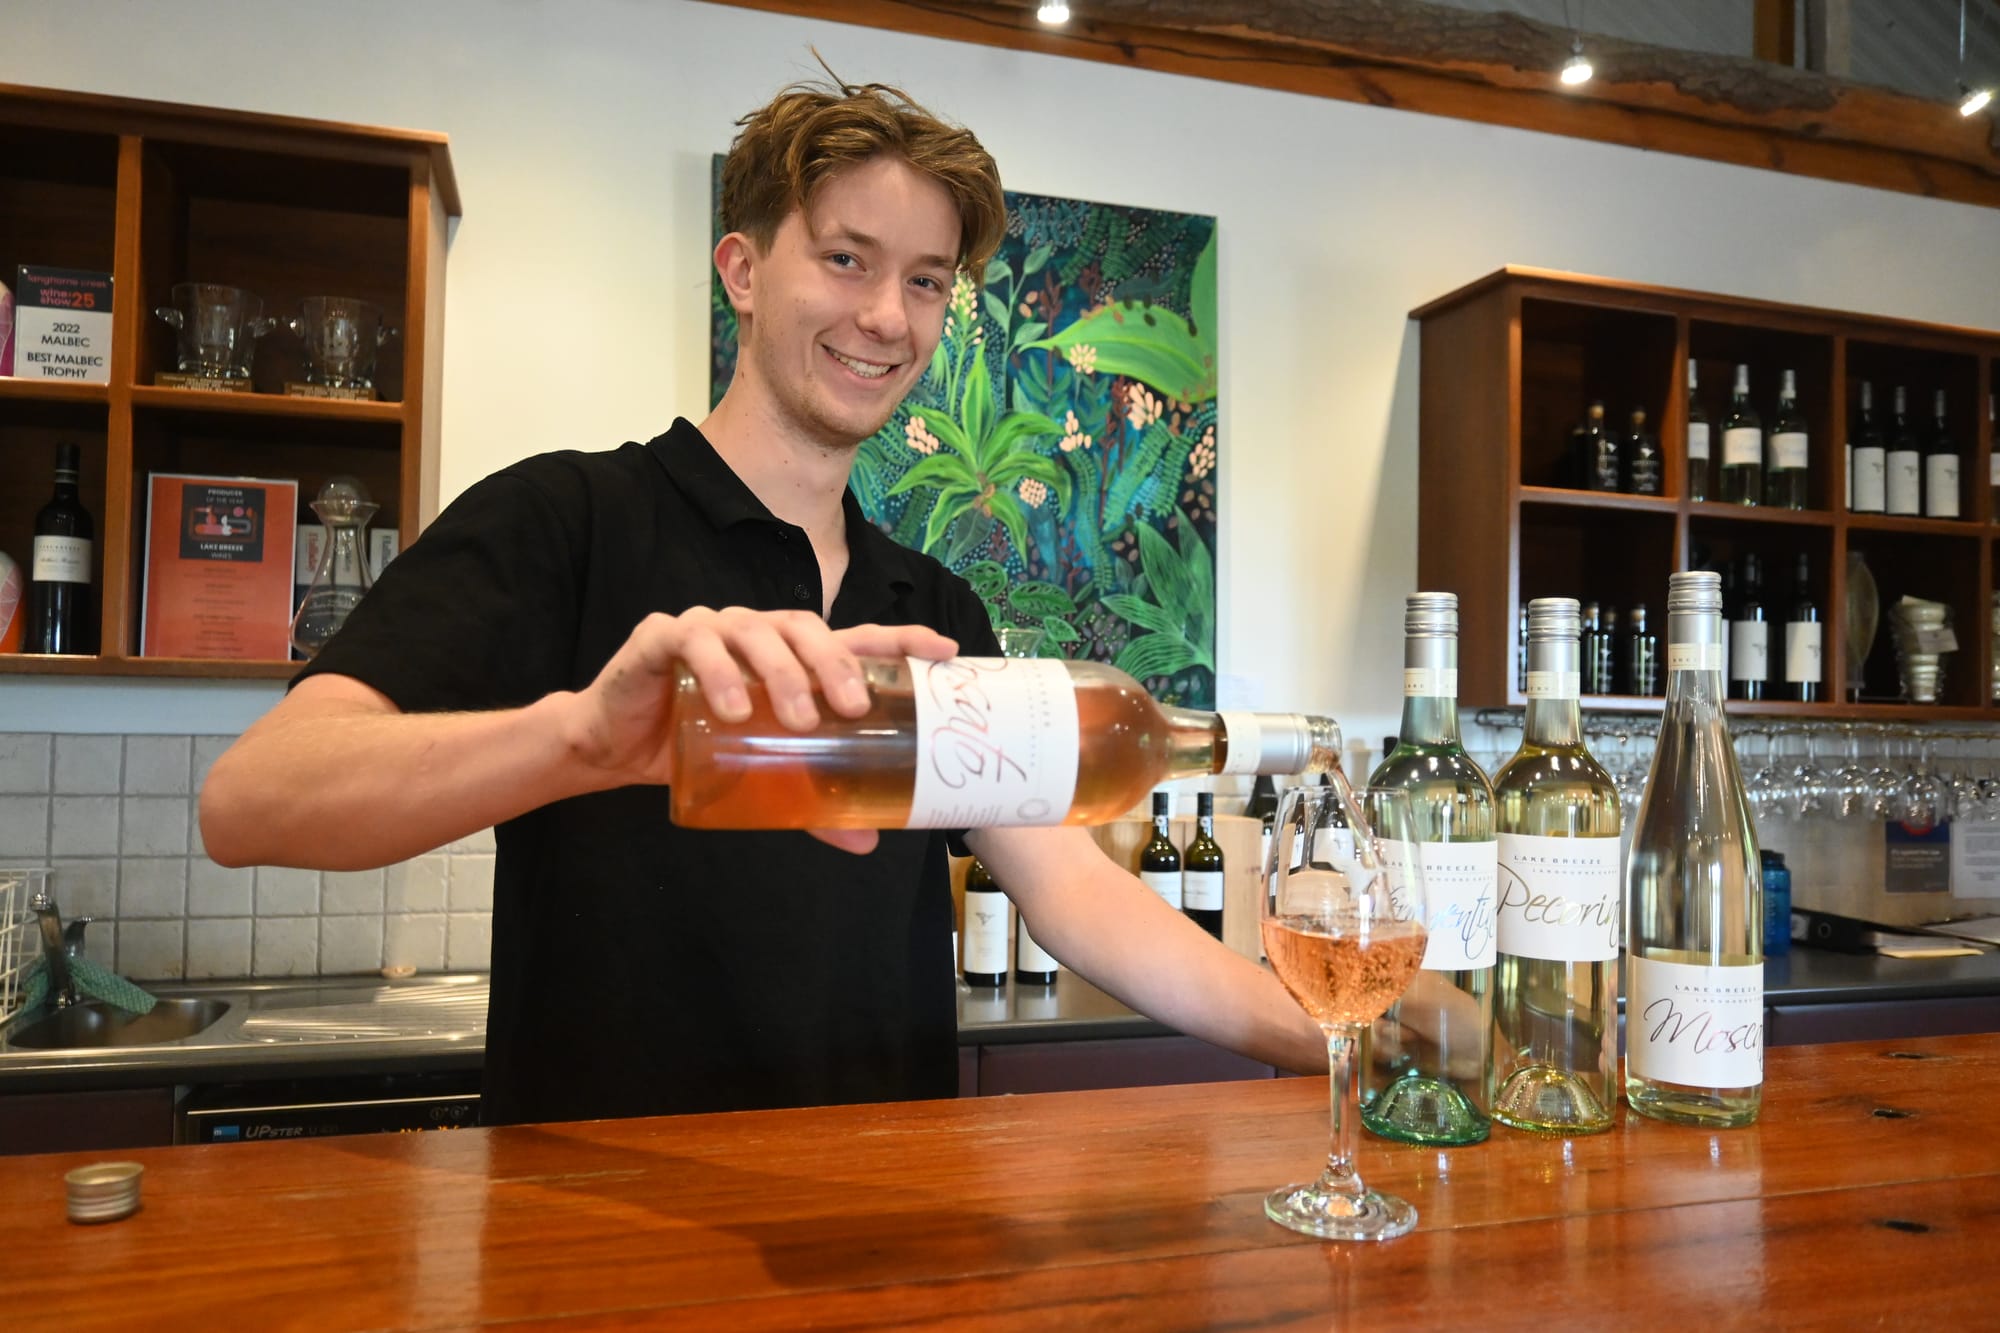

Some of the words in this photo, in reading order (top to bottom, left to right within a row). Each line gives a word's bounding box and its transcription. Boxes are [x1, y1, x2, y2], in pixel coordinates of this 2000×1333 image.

[40, 296, 71, 306] show
[72, 292, 95, 308] 25
[52, 322, 80, 334] 2022
[41, 335, 90, 348] MALBEC
[27, 351, 52, 363] BEST
[55, 353, 103, 366] MALBEC
[42, 365, 87, 379] TROPHY
[200, 543, 218, 551] LAKE
[219, 543, 244, 552] BREEZE
[1514, 855, 1545, 863] LAKE
[1426, 864, 1477, 872] BREEZE
[1675, 984, 1710, 992] LAKE
